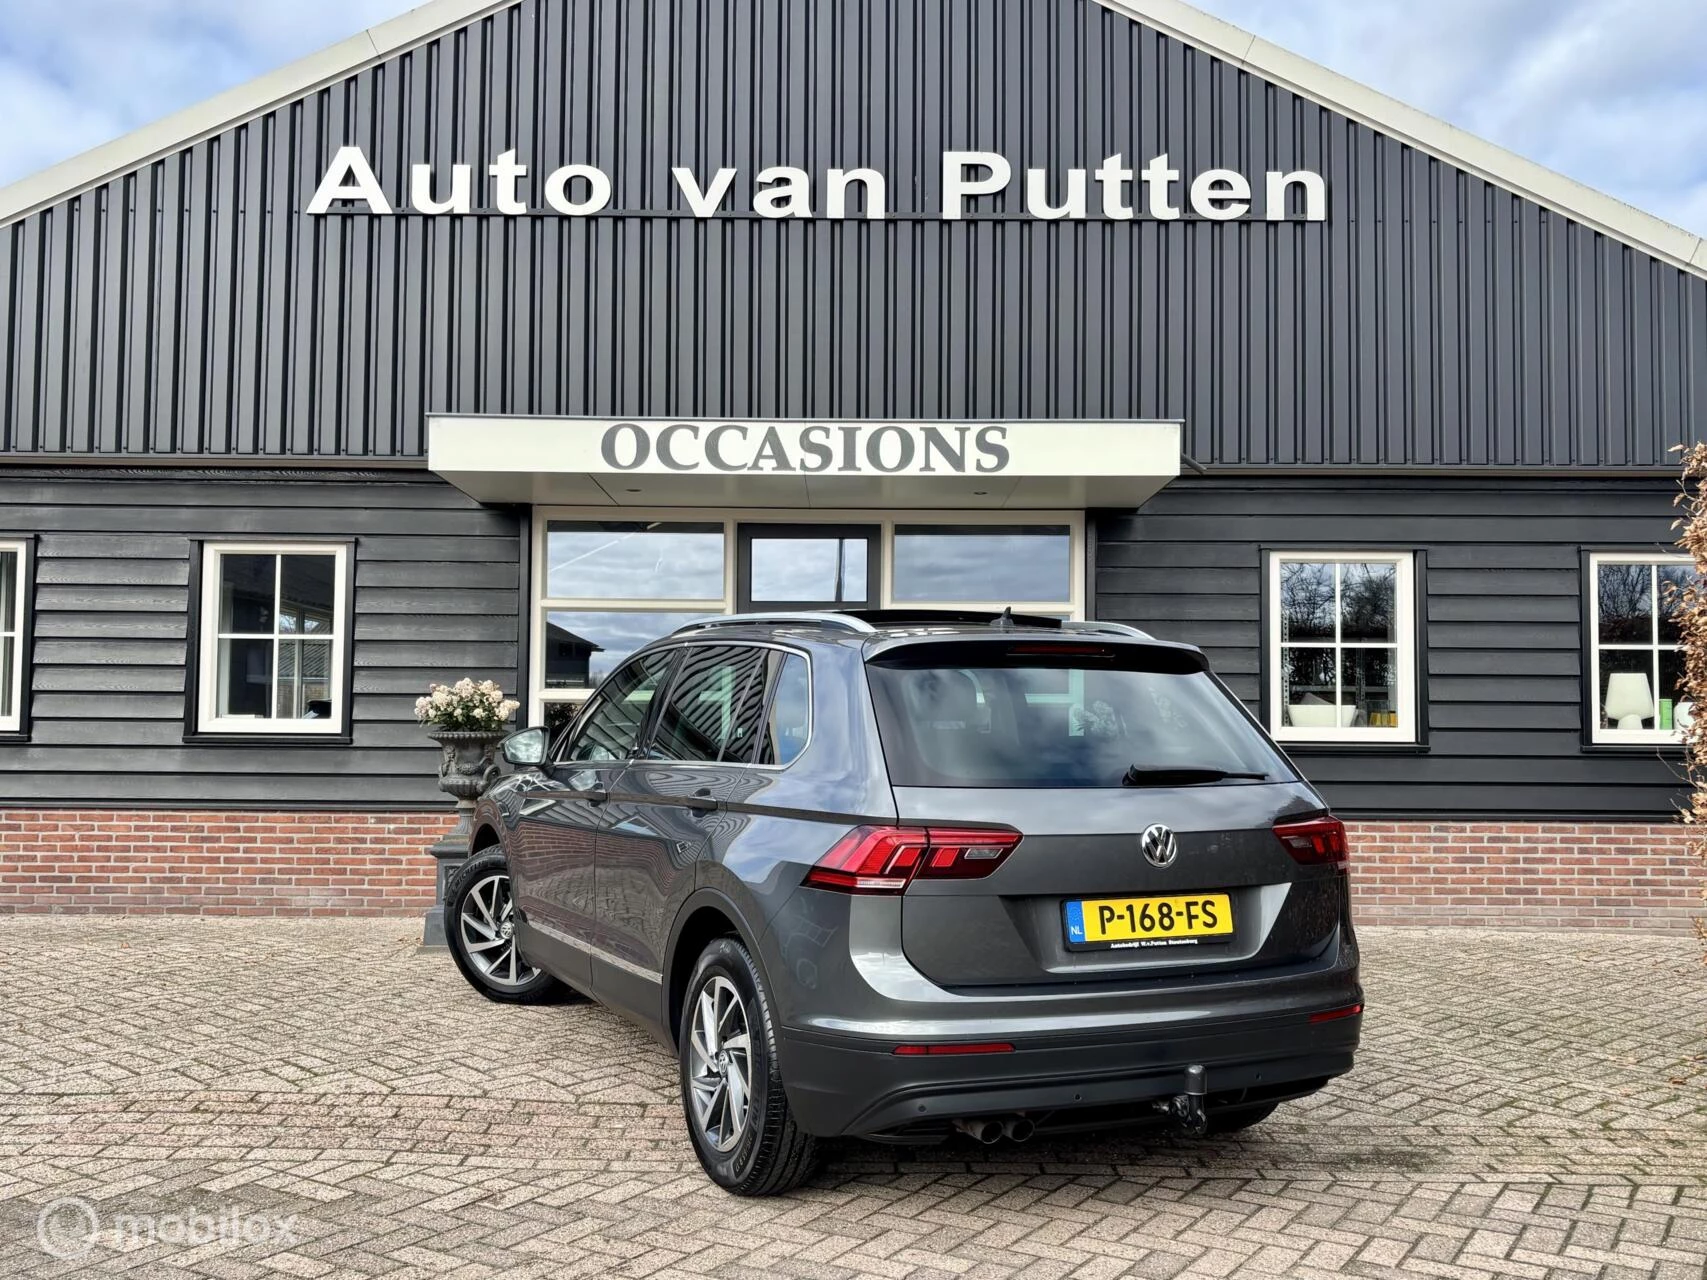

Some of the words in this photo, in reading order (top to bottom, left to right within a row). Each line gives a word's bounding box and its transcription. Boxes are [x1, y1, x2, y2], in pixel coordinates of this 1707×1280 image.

[306, 146, 612, 216] Auto
[672, 166, 886, 219] van
[943, 151, 1327, 222] Putten
[601, 422, 1010, 474] OCCASIONS
[1070, 926, 1083, 935] NL
[1098, 899, 1218, 935] P-168-FS
